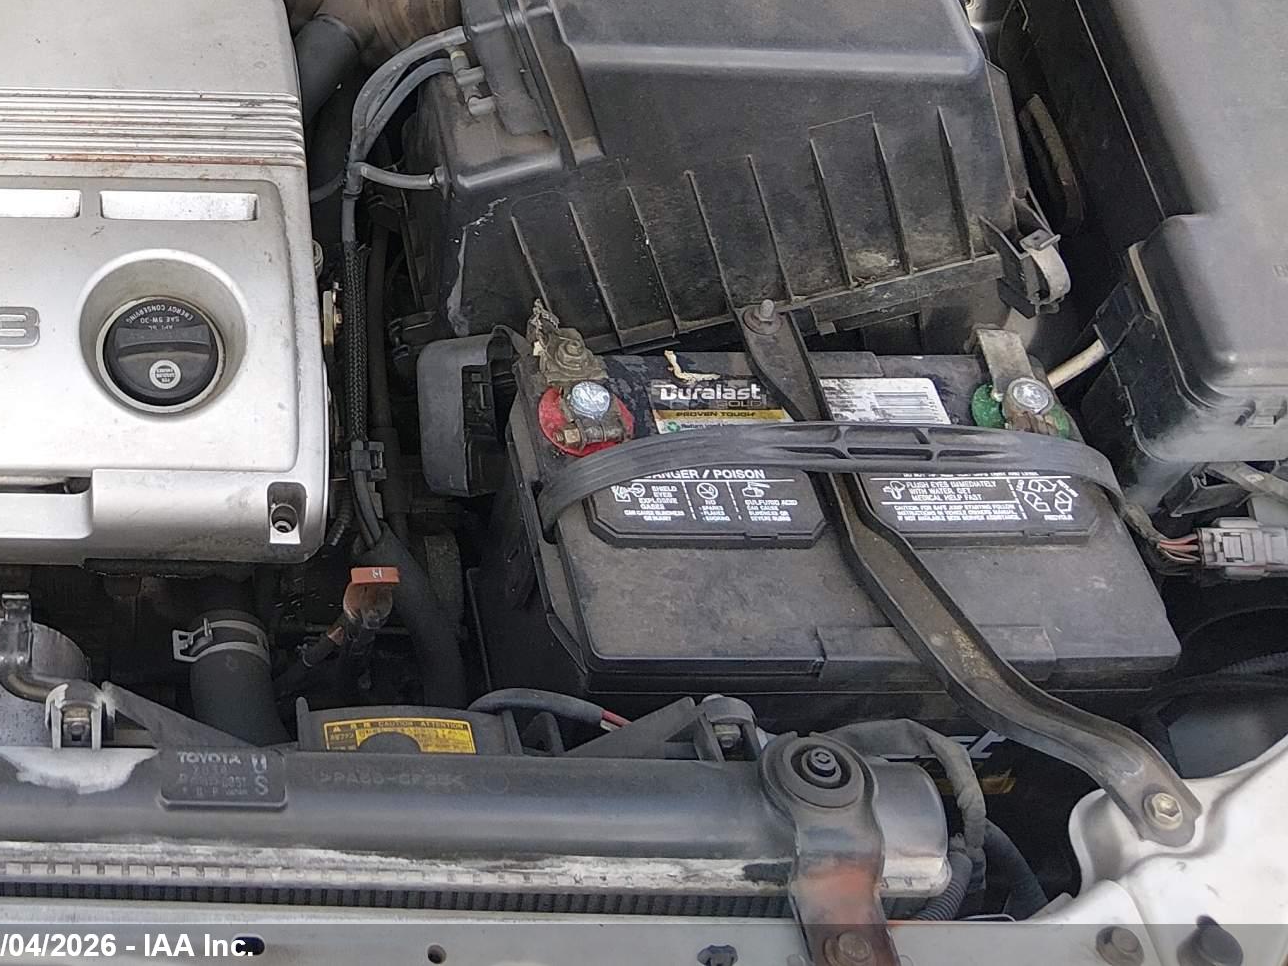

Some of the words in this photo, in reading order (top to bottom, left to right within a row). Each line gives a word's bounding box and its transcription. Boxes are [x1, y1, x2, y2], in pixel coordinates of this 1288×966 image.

[125, 304, 166, 324] CONSERVING
[140, 316, 164, 324] 5W-30
[167, 306, 194, 321] ENERGY
[653, 384, 761, 400] Duralast
[644, 470, 699, 479] ANGER
[712, 469, 766, 479] POISON
[951, 480, 997, 488] IMMEDIATELY
[176, 751, 241, 765] TOYOTA
